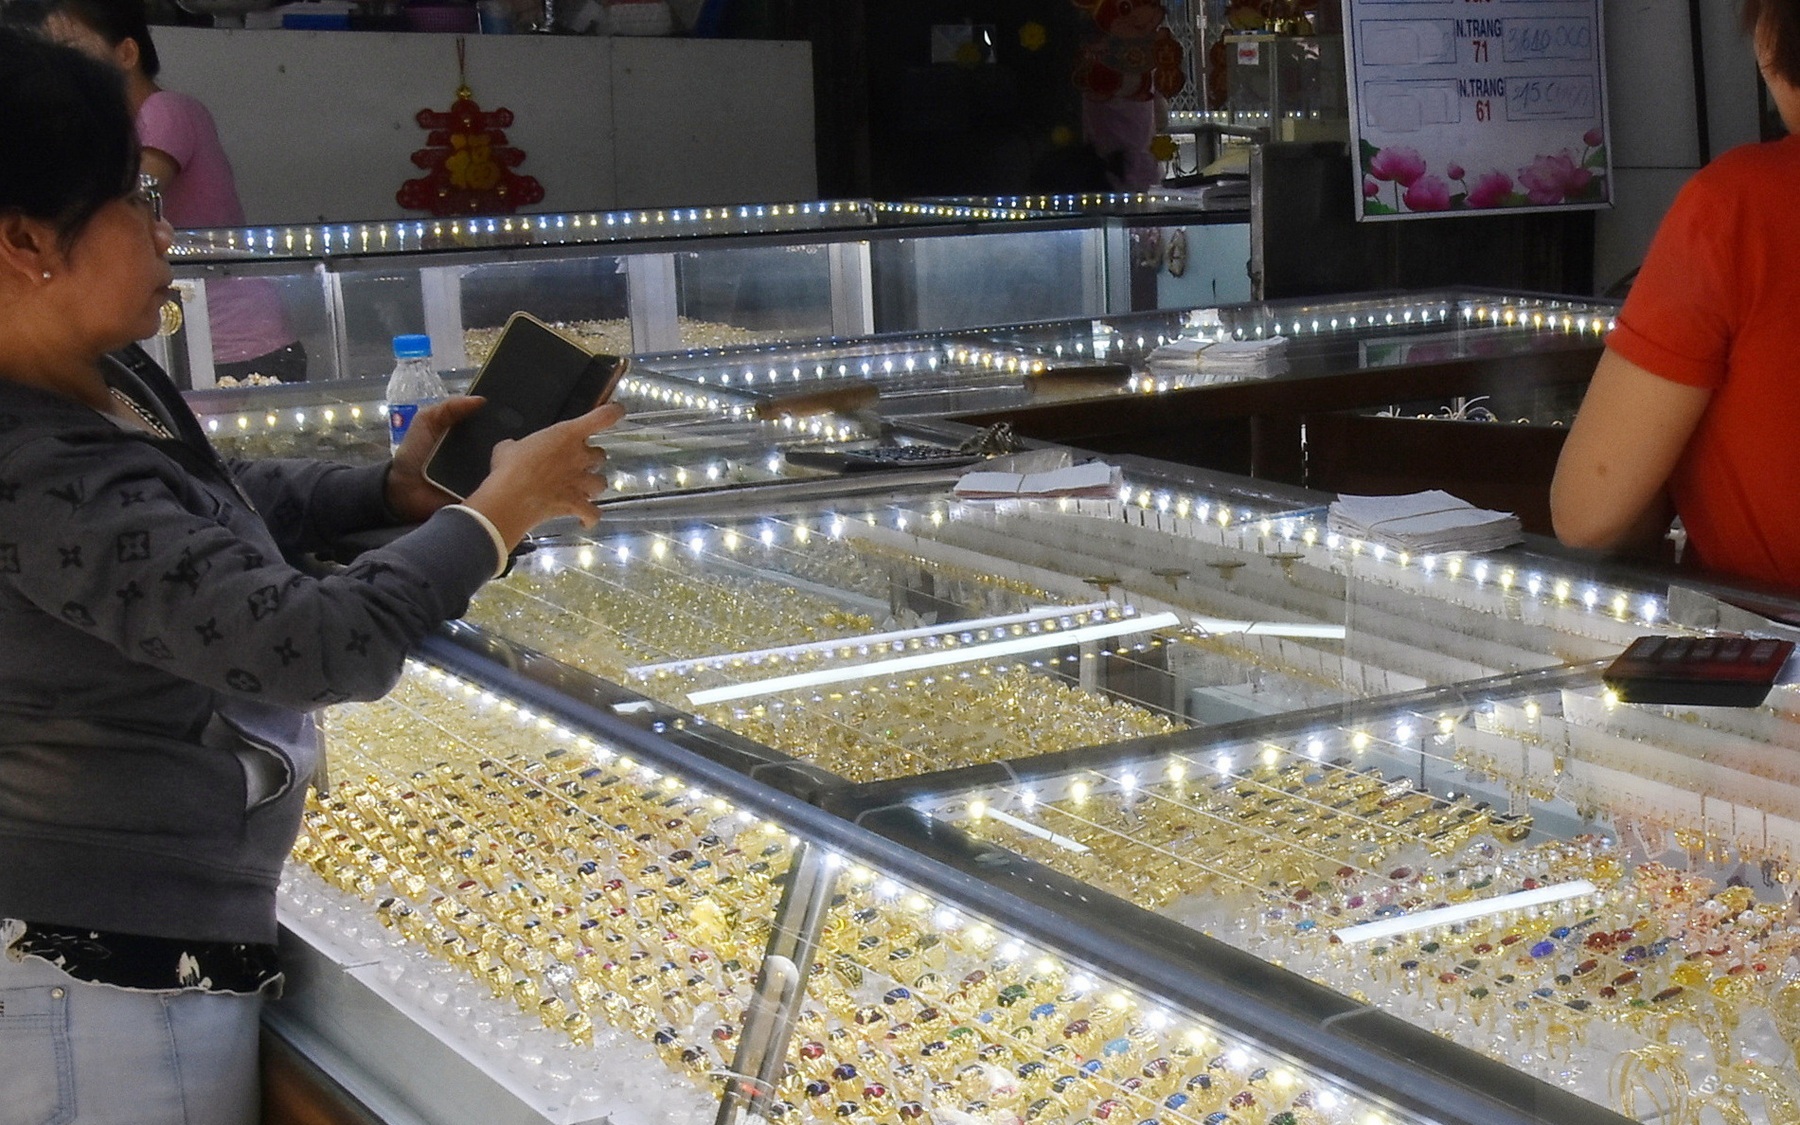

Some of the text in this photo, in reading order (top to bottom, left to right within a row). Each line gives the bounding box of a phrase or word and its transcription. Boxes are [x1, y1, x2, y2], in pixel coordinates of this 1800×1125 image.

[1456, 18, 1501, 37] N.TRANG
[1472, 40, 1488, 63] 71
[1459, 77, 1504, 98] N.TRANG
[1476, 100, 1491, 122] 61
